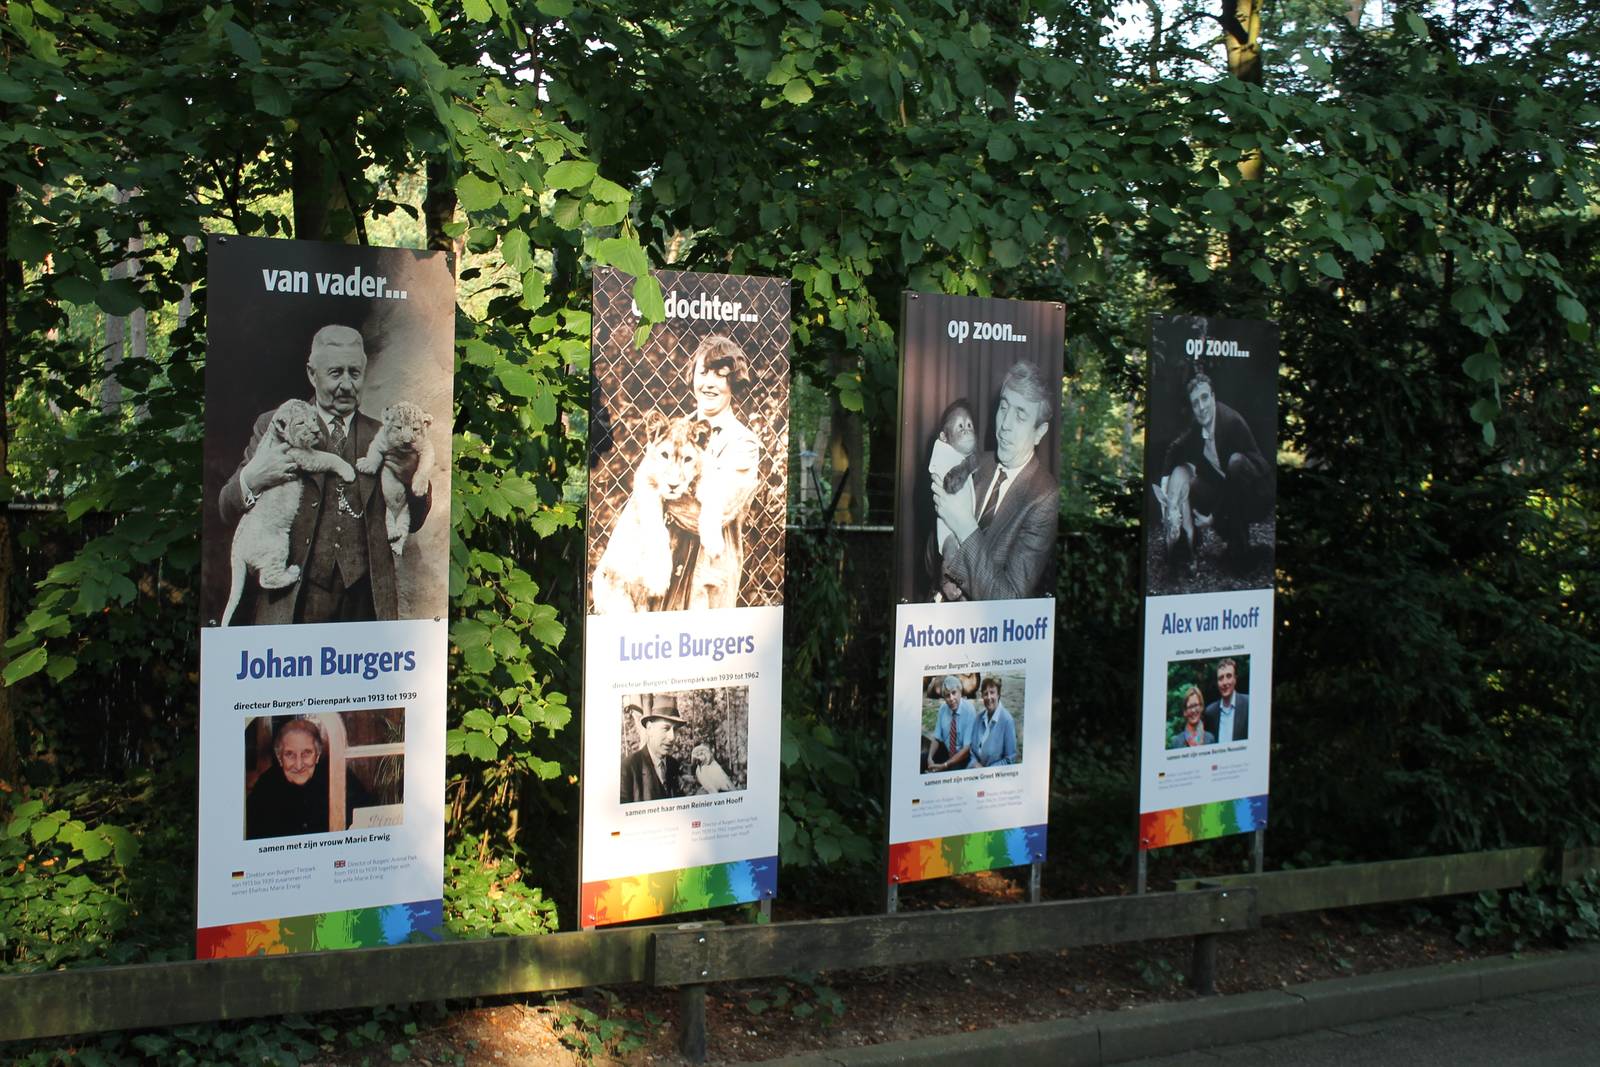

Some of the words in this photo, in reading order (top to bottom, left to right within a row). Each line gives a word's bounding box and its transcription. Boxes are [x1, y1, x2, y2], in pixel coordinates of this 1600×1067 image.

[262, 269, 309, 293] van
[315, 266, 408, 299] vader...
[664, 290, 759, 322] dochter...
[948, 320, 968, 343] op
[973, 320, 1027, 343] zoon...
[1185, 339, 1204, 360] op
[1206, 339, 1250, 357] zoon...
[1161, 612, 1192, 635] Alex
[1195, 615, 1219, 632] van
[1222, 606, 1259, 630] Hooff
[903, 623, 965, 648] Antoon
[970, 625, 998, 644] van
[1002, 616, 1048, 642] Hooff
[619, 634, 672, 662] Lucie
[678, 632, 755, 662] Burgers
[236, 648, 313, 680] Johan
[320, 646, 416, 680] Burgers
[924, 663, 947, 671] directeur
[612, 681, 642, 689] directeur
[670, 677, 705, 686] Dierenpark
[744, 671, 759, 679] 1962
[233, 701, 271, 711] directeur
[272, 699, 306, 709] Burgers'
[307, 696, 351, 706] Dierenpark
[368, 694, 385, 702] 1913
[399, 692, 417, 700] 1939
[953, 776, 962, 784] zijn
[625, 809, 646, 817] samen
[661, 804, 675, 812] haar
[690, 800, 713, 808] Reinier
[725, 796, 744, 804] Hooff
[258, 845, 285, 853] samen
[303, 840, 318, 850] zijn
[319, 839, 344, 847] vrouw
[344, 835, 368, 844] Marie
[369, 832, 391, 842] Erwig
